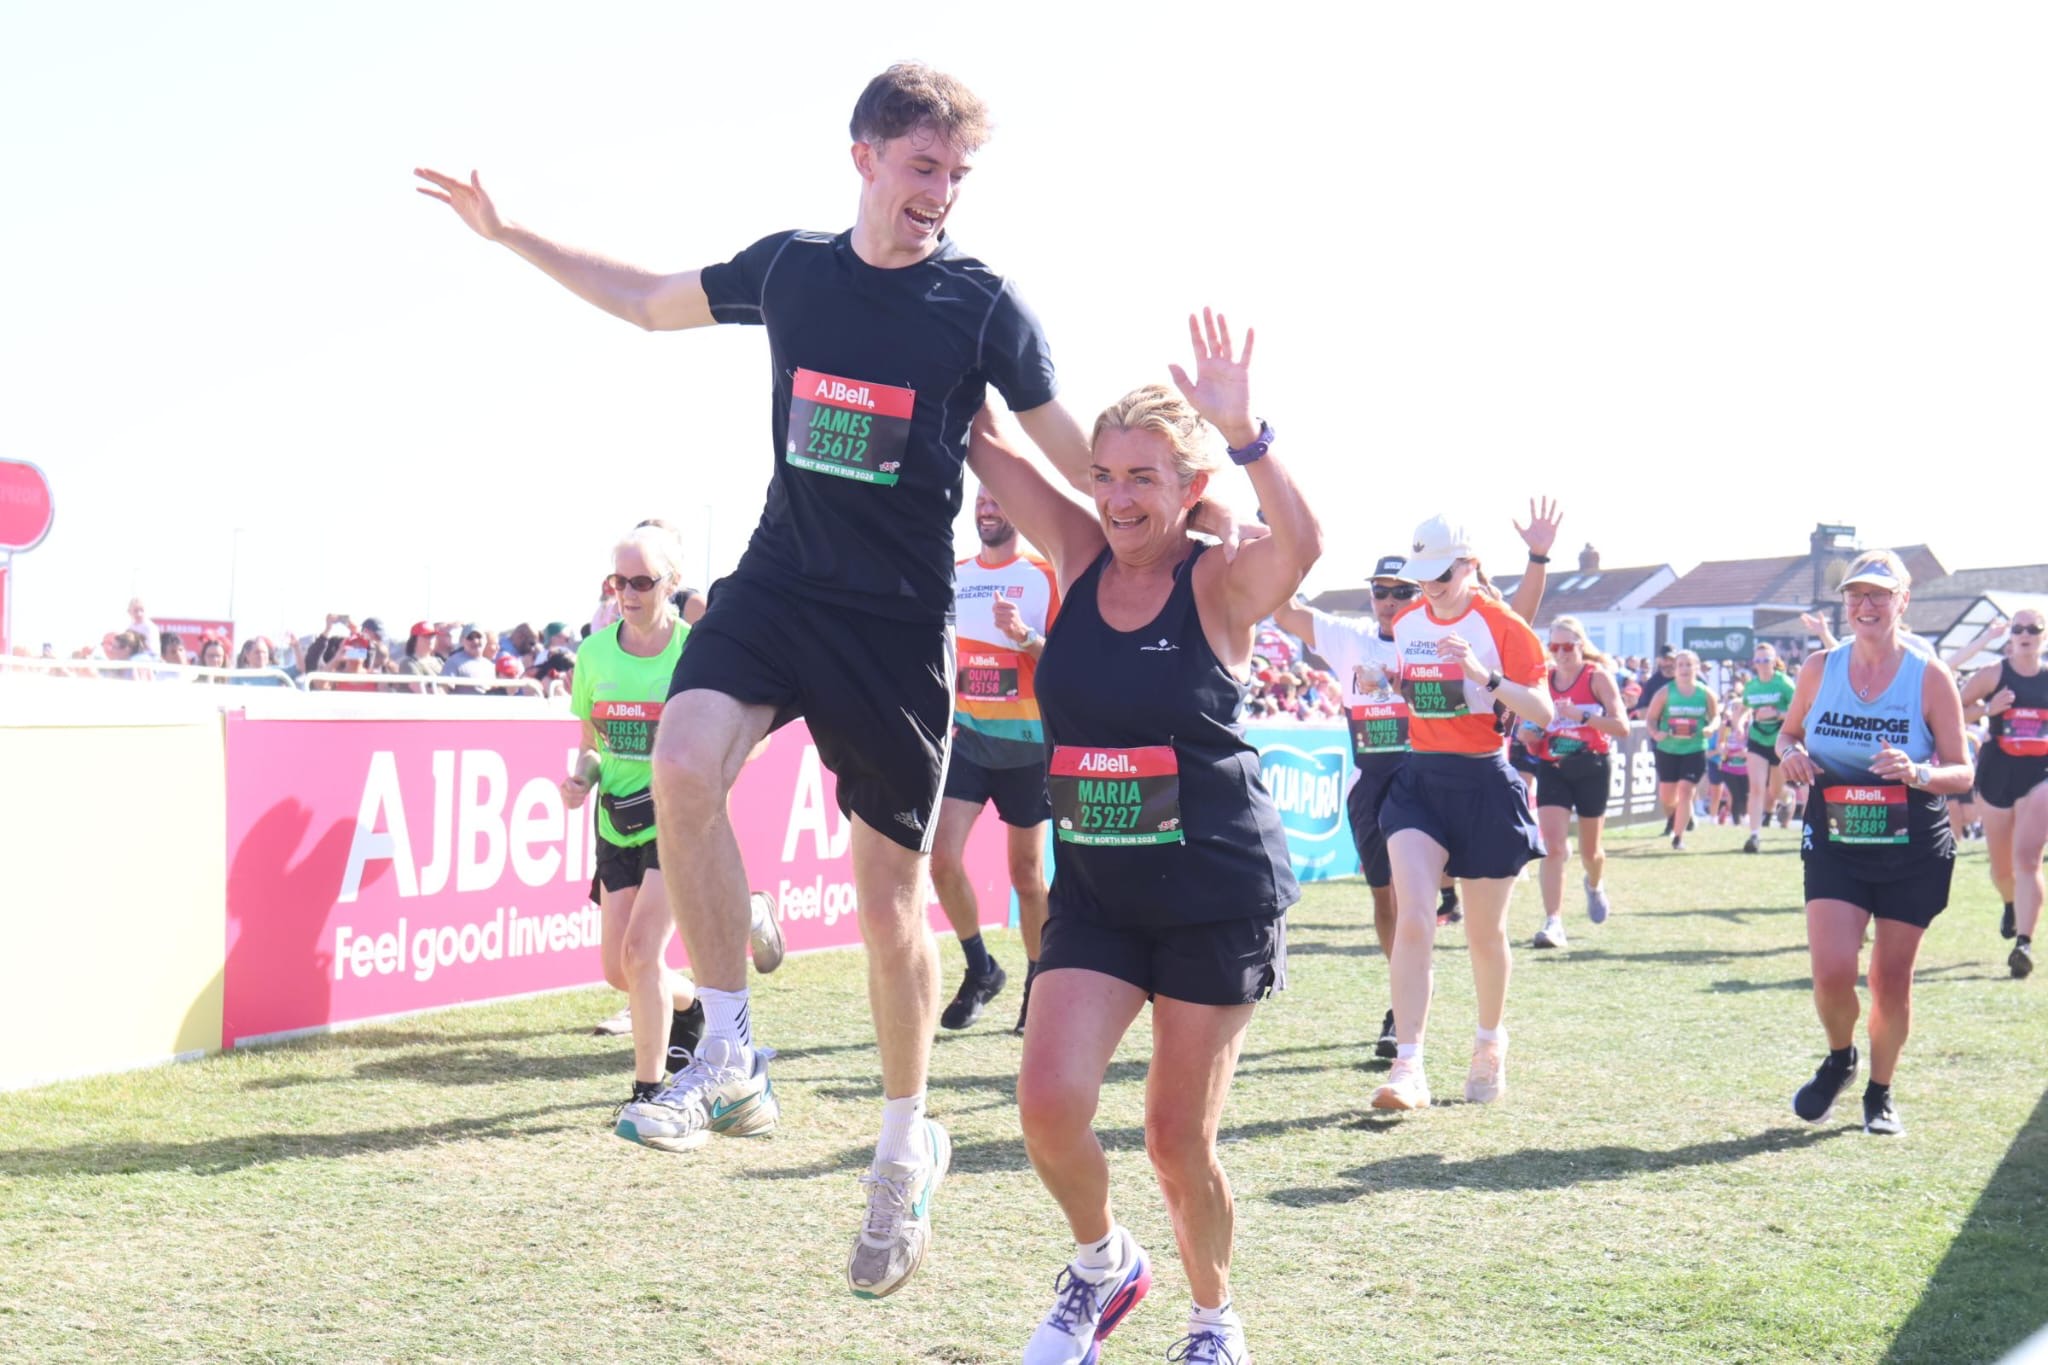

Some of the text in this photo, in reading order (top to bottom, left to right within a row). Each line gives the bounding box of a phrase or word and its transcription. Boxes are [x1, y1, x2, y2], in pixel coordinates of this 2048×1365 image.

[808, 405, 873, 439] JAMES
[806, 430, 868, 463] 25612
[968, 669, 1001, 681] OLIVIA
[969, 681, 1000, 694] 45158
[1414, 682, 1442, 695] KARA
[1415, 695, 1448, 710] 25792
[607, 720, 648, 735] TERESA
[1366, 718, 1398, 732] DANIEL
[1817, 710, 1910, 734] ALDRIDGE
[610, 735, 648, 750] 25948
[1814, 726, 1873, 742] RUNNING
[1875, 733, 1909, 745] CLUB
[1078, 779, 1142, 804] MARIA
[1081, 804, 1143, 829] 25227
[1844, 805, 1888, 819] SARAH
[1845, 819, 1887, 834] 25889
[778, 874, 823, 922] Feel
[335, 900, 602, 982] Feel good investi
